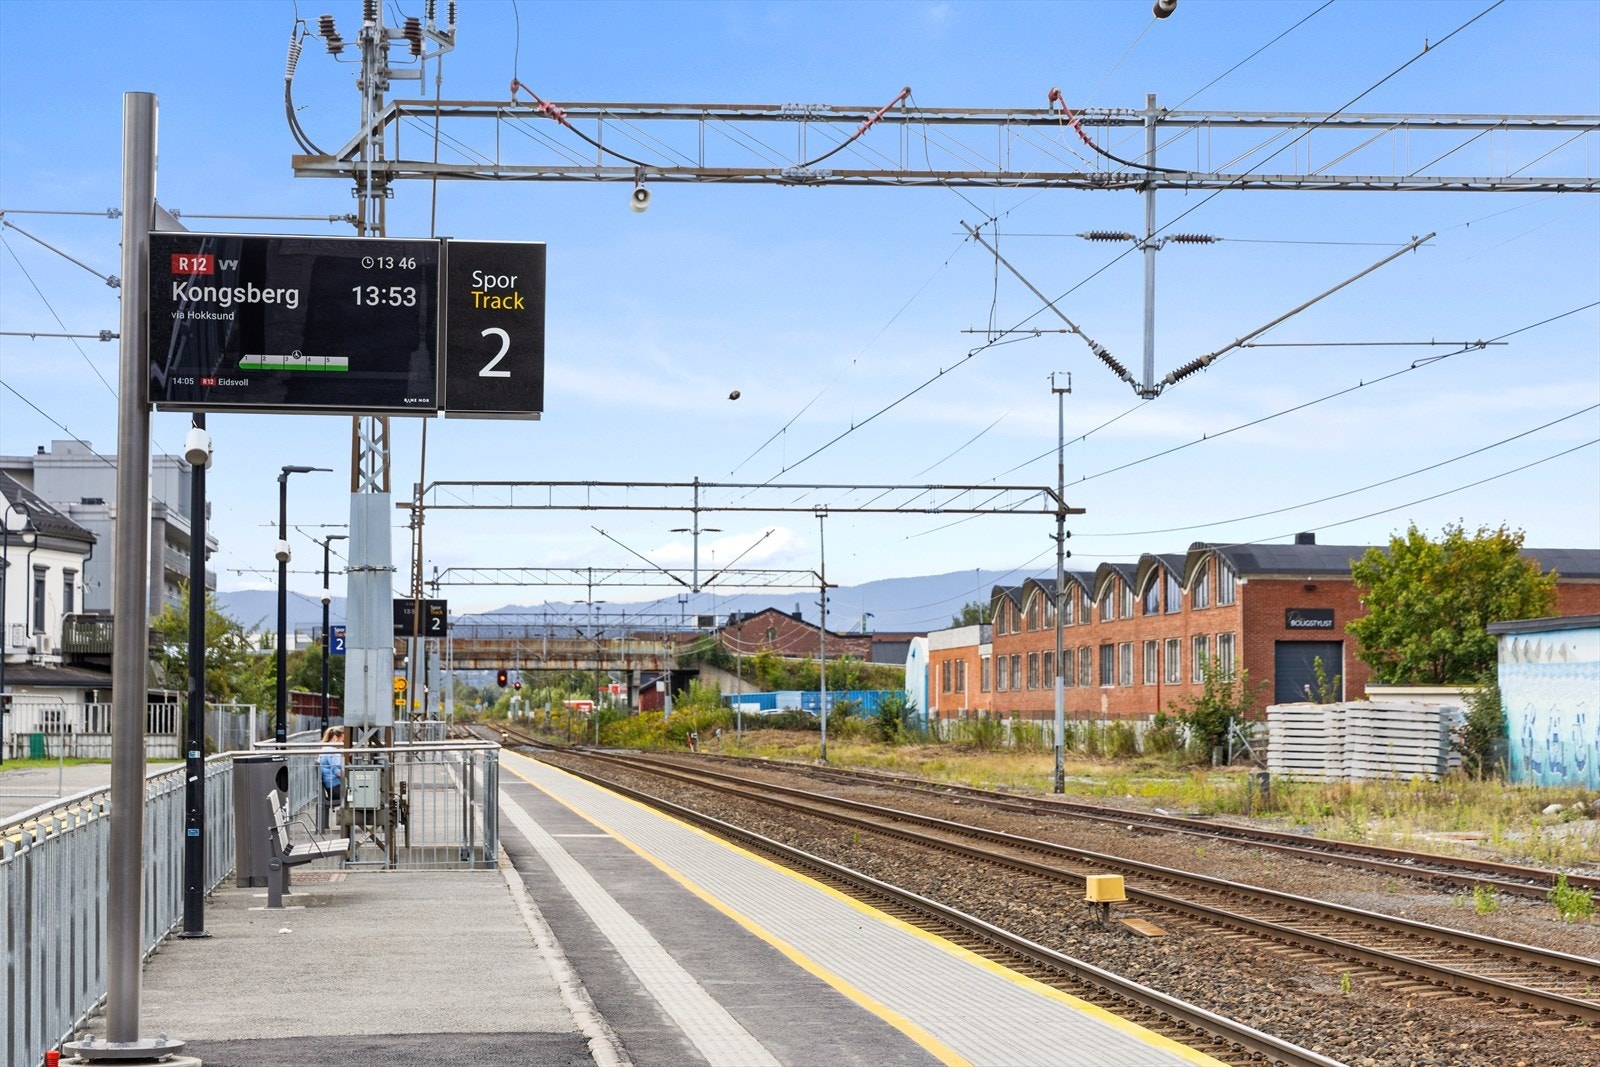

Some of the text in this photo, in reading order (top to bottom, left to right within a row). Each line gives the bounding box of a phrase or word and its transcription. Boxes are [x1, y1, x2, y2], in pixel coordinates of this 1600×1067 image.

[472, 270, 518, 292] Spor
[172, 281, 299, 309] Kongsberg
[352, 286, 417, 307] 13:53
[471, 291, 525, 310] Track
[171, 311, 235, 320] via Hokksund
[479, 327, 511, 378] 2
[173, 377, 195, 385] 14:05
[218, 378, 249, 386] Eidsvoll
[431, 617, 441, 630] 2
[335, 638, 344, 650] 2
